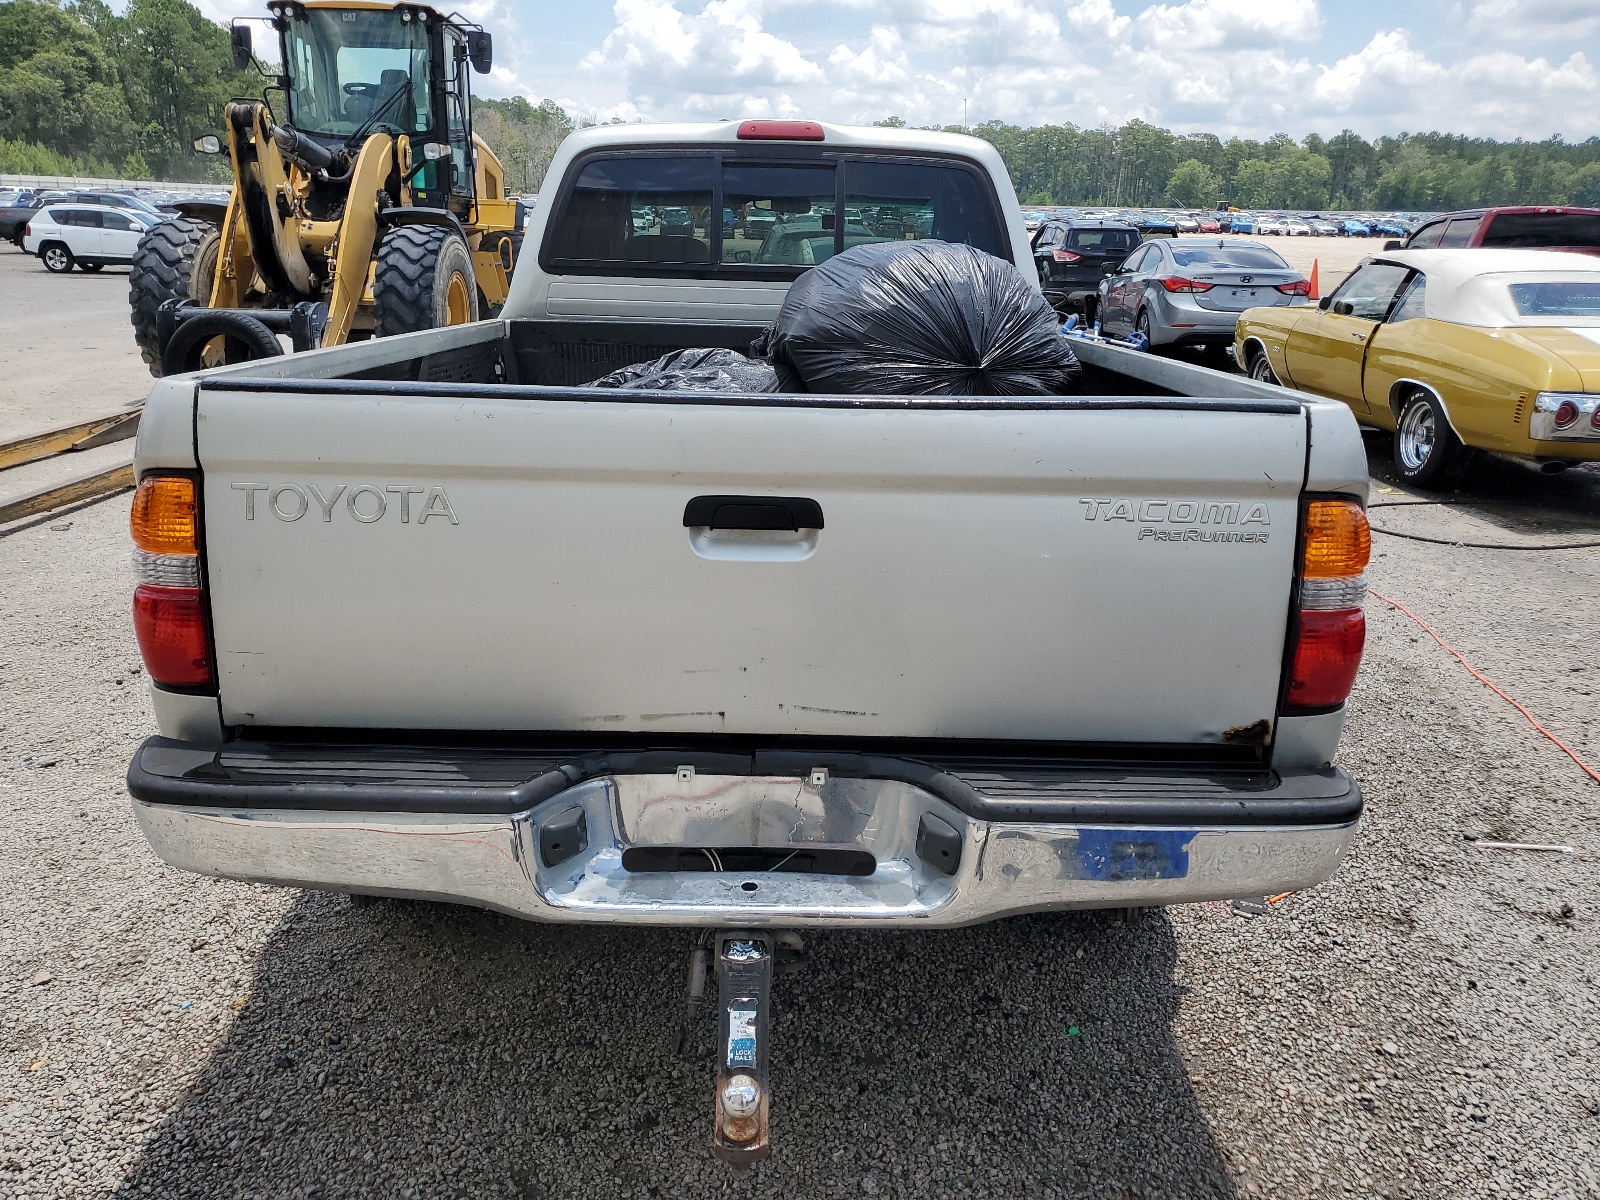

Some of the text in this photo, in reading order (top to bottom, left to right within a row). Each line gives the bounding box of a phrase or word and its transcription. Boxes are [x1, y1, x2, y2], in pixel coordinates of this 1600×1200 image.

[342, 12, 357, 22] CAT
[230, 481, 460, 526] TOYOTA
[1079, 497, 1271, 526] TACOMA
